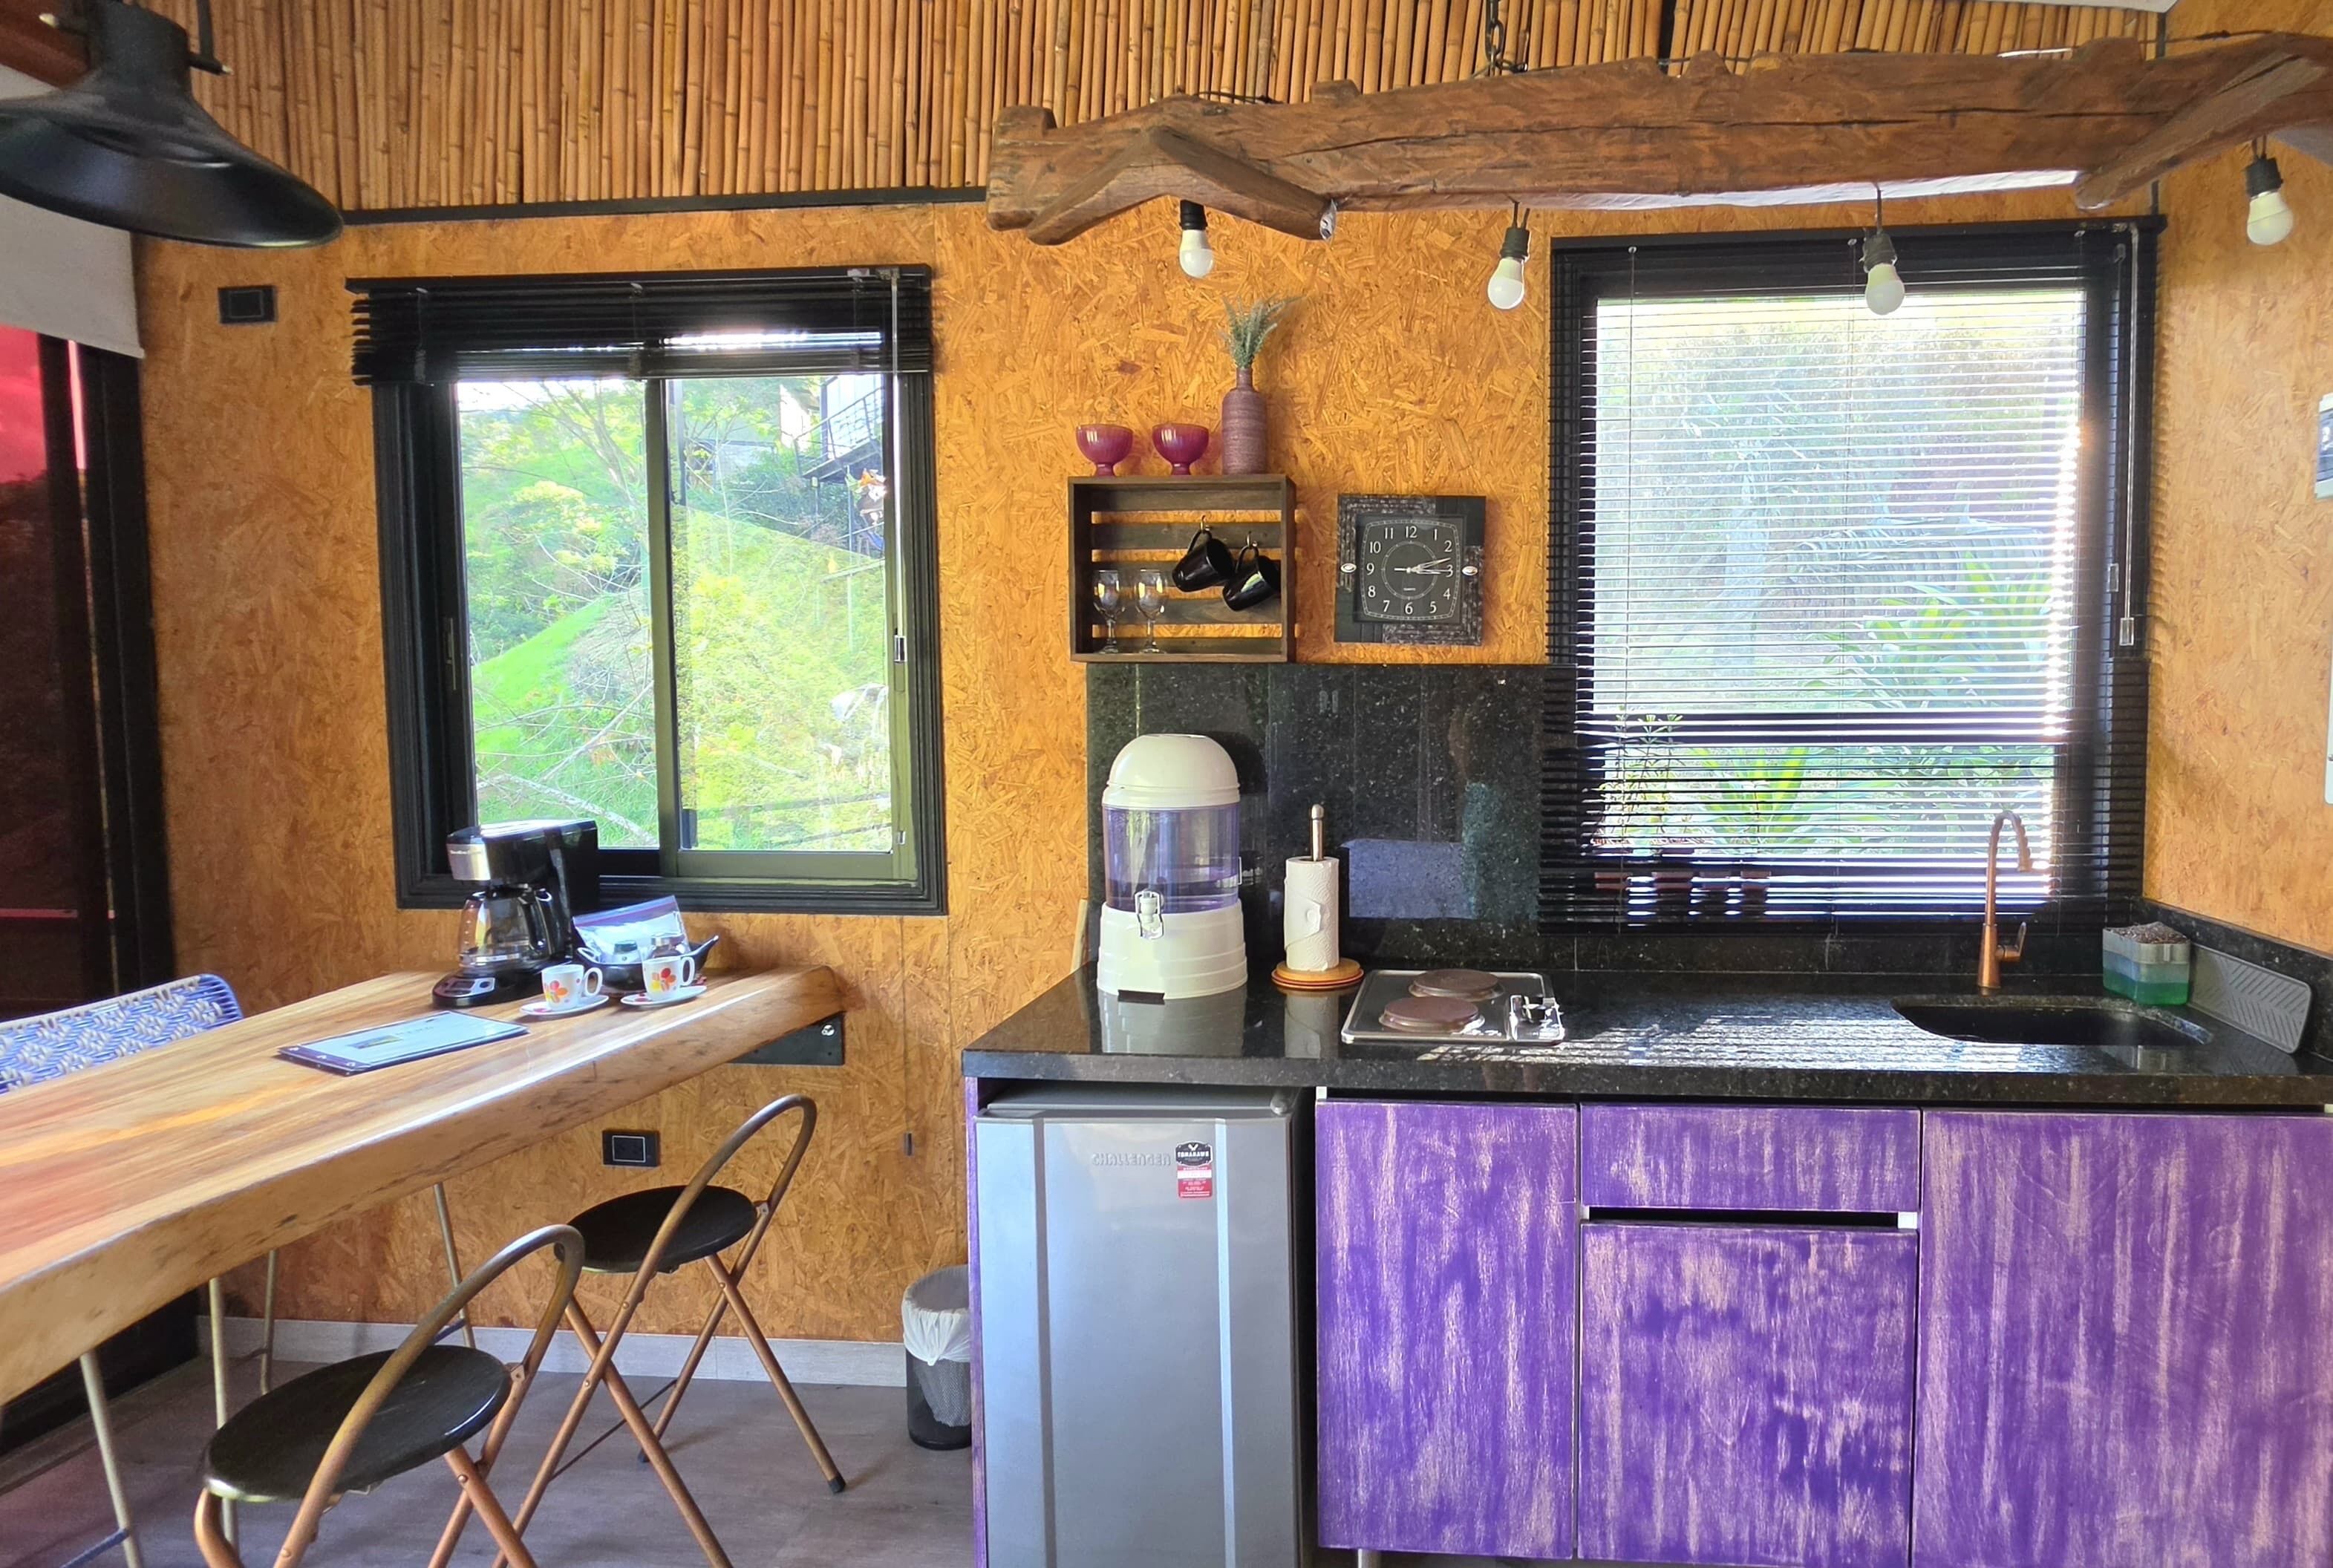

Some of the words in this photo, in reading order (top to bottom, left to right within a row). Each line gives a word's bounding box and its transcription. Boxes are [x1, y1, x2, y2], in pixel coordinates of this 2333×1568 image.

[1385, 527, 1394, 539] 11
[1405, 526, 1417, 538] 12
[1434, 529, 1438, 540] 1
[1369, 541, 1381, 553] 10
[1444, 540, 1452, 552] 2
[1366, 563, 1374, 575] 9
[1446, 564, 1453, 578] 3
[1368, 585, 1376, 598] 8
[1443, 588, 1451, 600] 4
[1383, 600, 1390, 612] 7
[1405, 602, 1413, 615] 6
[1429, 601, 1437, 613] 5
[1092, 1152, 1171, 1166] CHALLENGER
